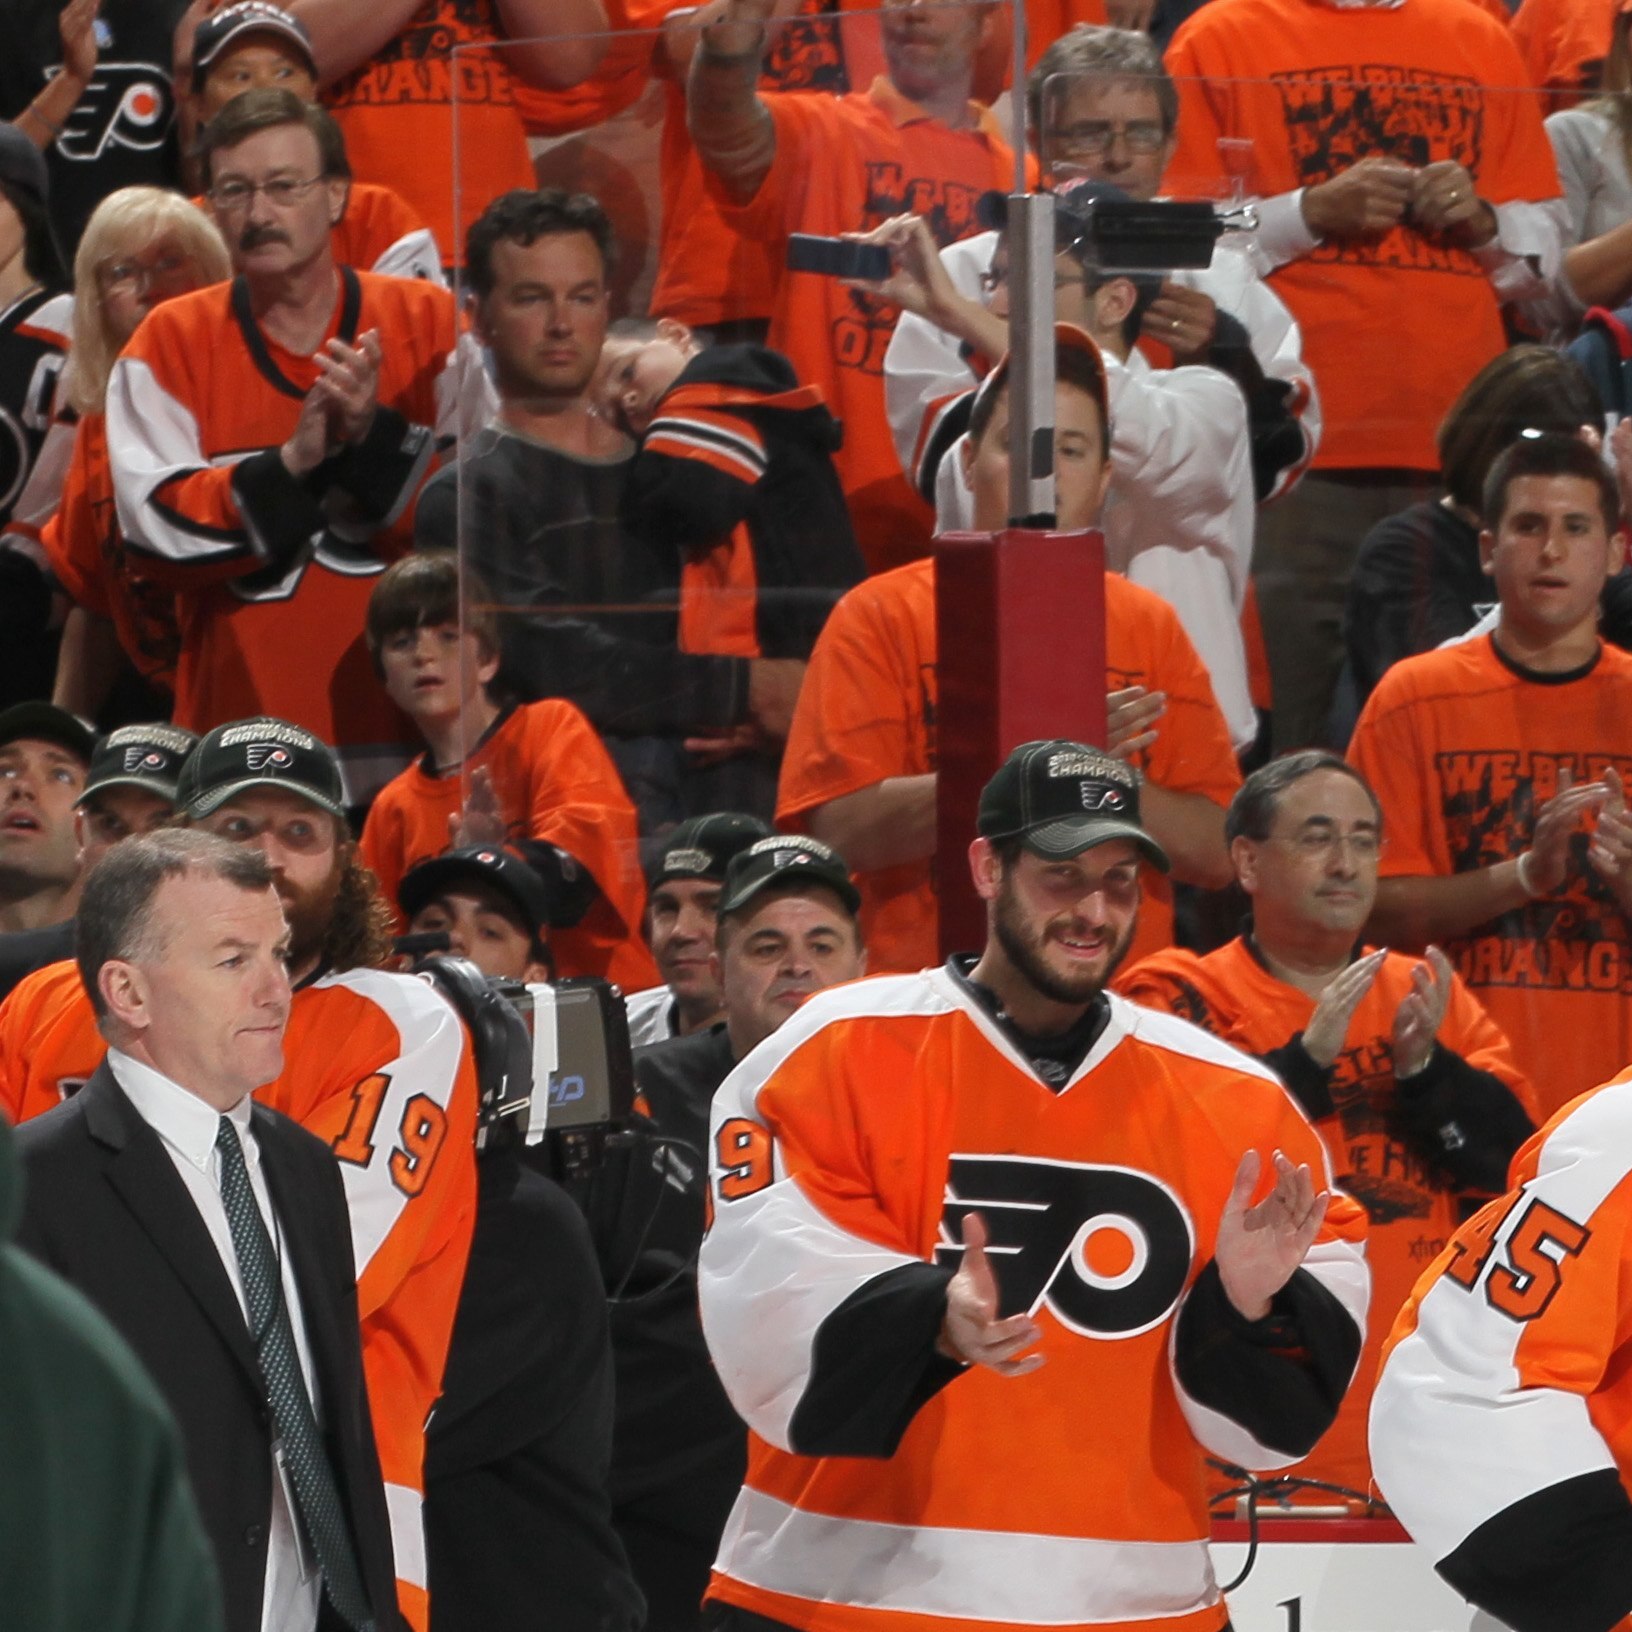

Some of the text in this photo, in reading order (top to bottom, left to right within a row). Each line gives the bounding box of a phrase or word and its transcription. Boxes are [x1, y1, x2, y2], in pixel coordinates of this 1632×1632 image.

[1436, 750, 1521, 800] WE
[333, 1070, 448, 1200] 19
[714, 1116, 774, 1202] 9
